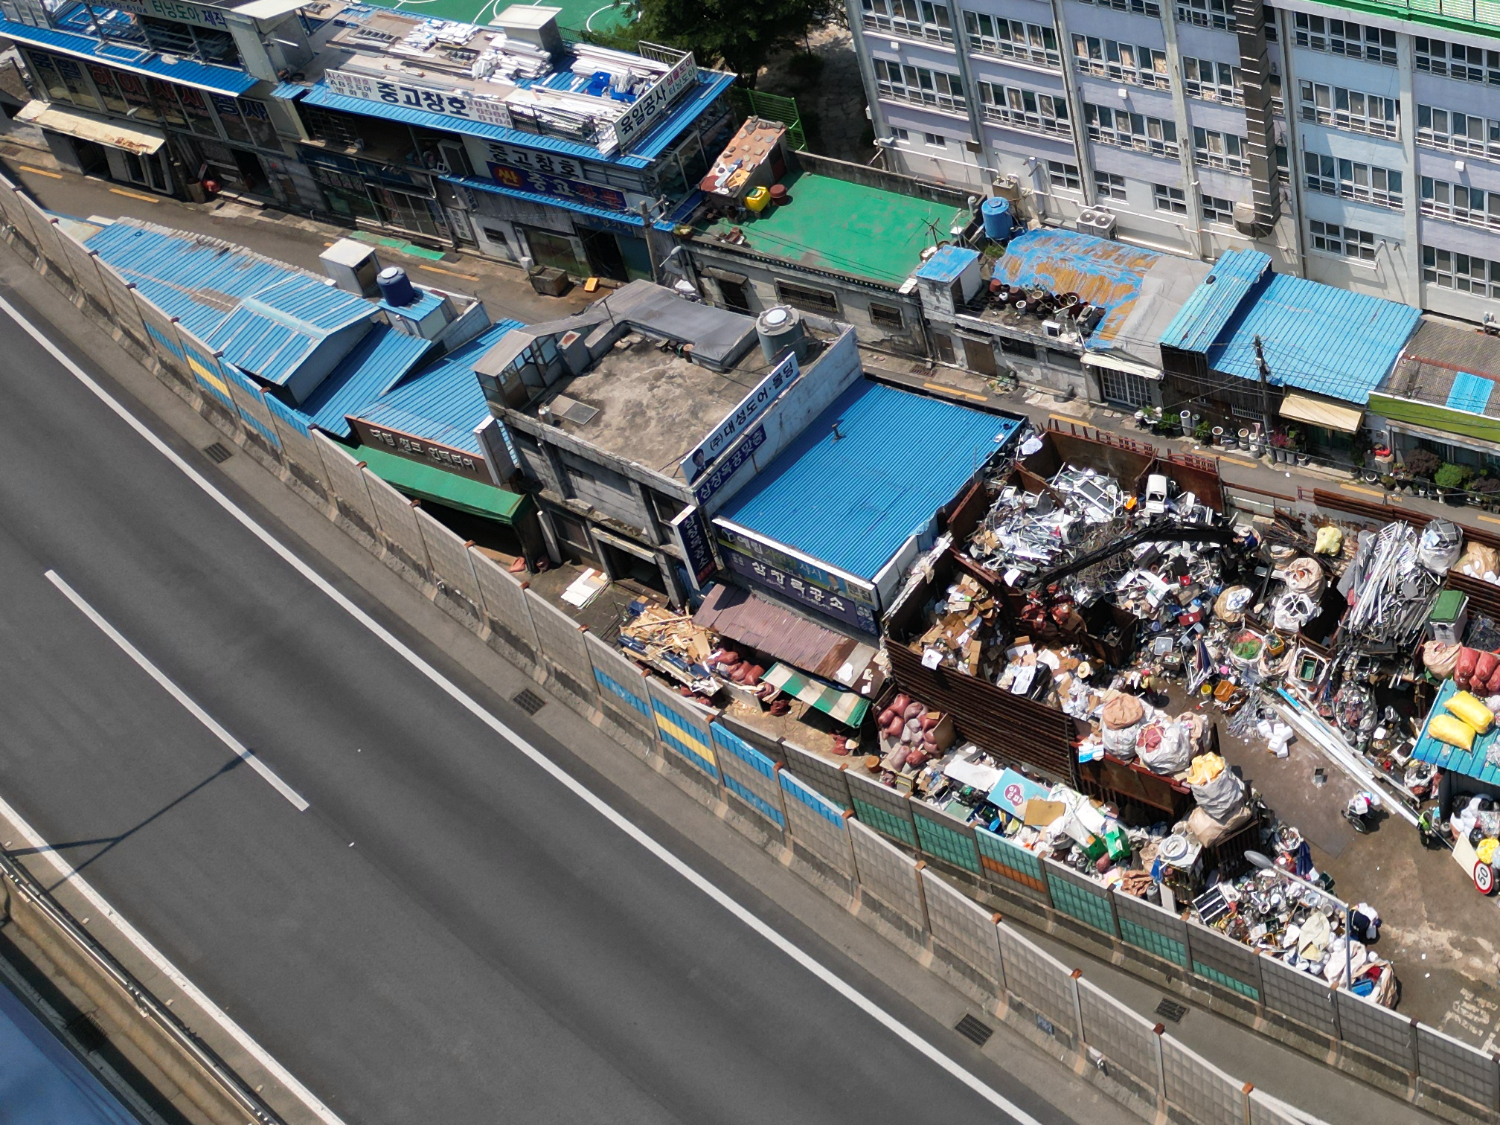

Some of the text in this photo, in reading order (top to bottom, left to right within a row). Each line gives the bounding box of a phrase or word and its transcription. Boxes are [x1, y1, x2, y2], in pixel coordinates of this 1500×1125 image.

[376, 81, 470, 118] 중고창호
[621, 84, 667, 136] 육일공사
[488, 143, 580, 178] 중고창호
[527, 172, 574, 198] 중고
[751, 560, 846, 613] 삼창목공소
[1477, 866, 1489, 886] 50
